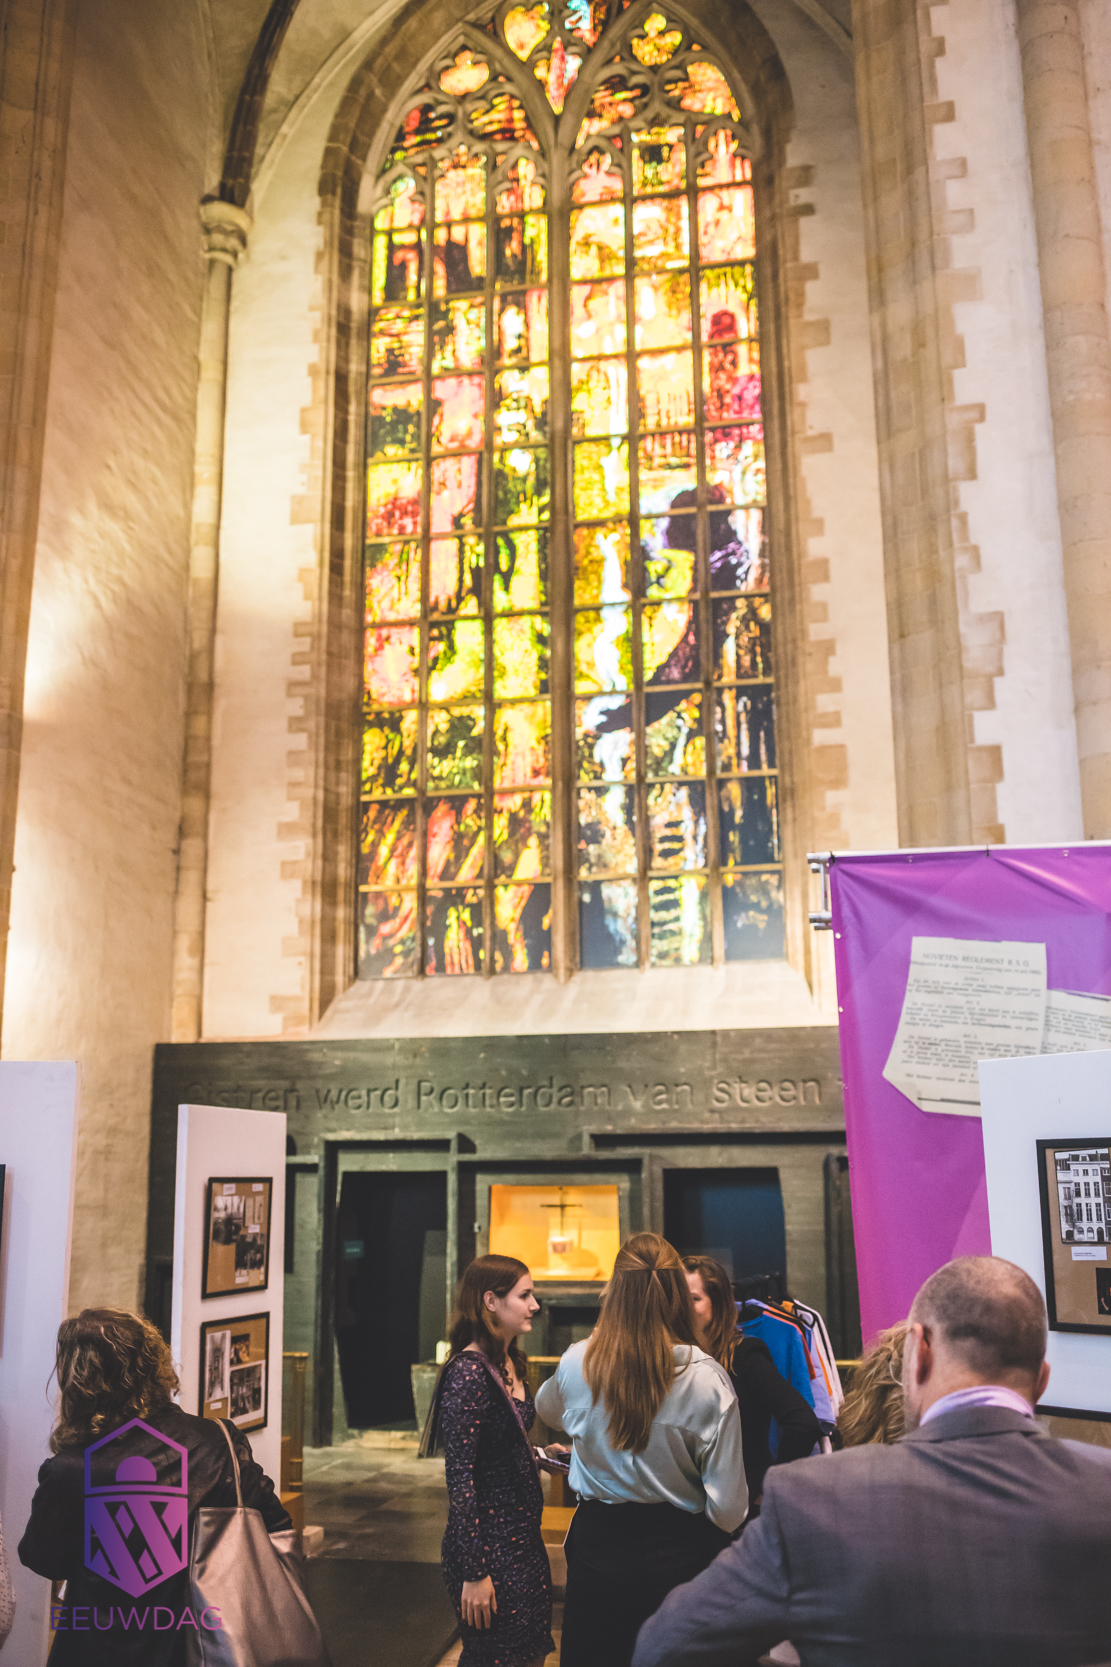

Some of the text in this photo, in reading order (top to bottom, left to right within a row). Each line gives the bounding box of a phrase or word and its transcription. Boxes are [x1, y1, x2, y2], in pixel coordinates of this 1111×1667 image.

[961, 955, 1004, 966] REGLEMENT
[315, 1078, 400, 1113] werd
[416, 1076, 612, 1113] Rotterdam
[625, 1081, 695, 1110] van
[711, 1075, 822, 1108] steen
